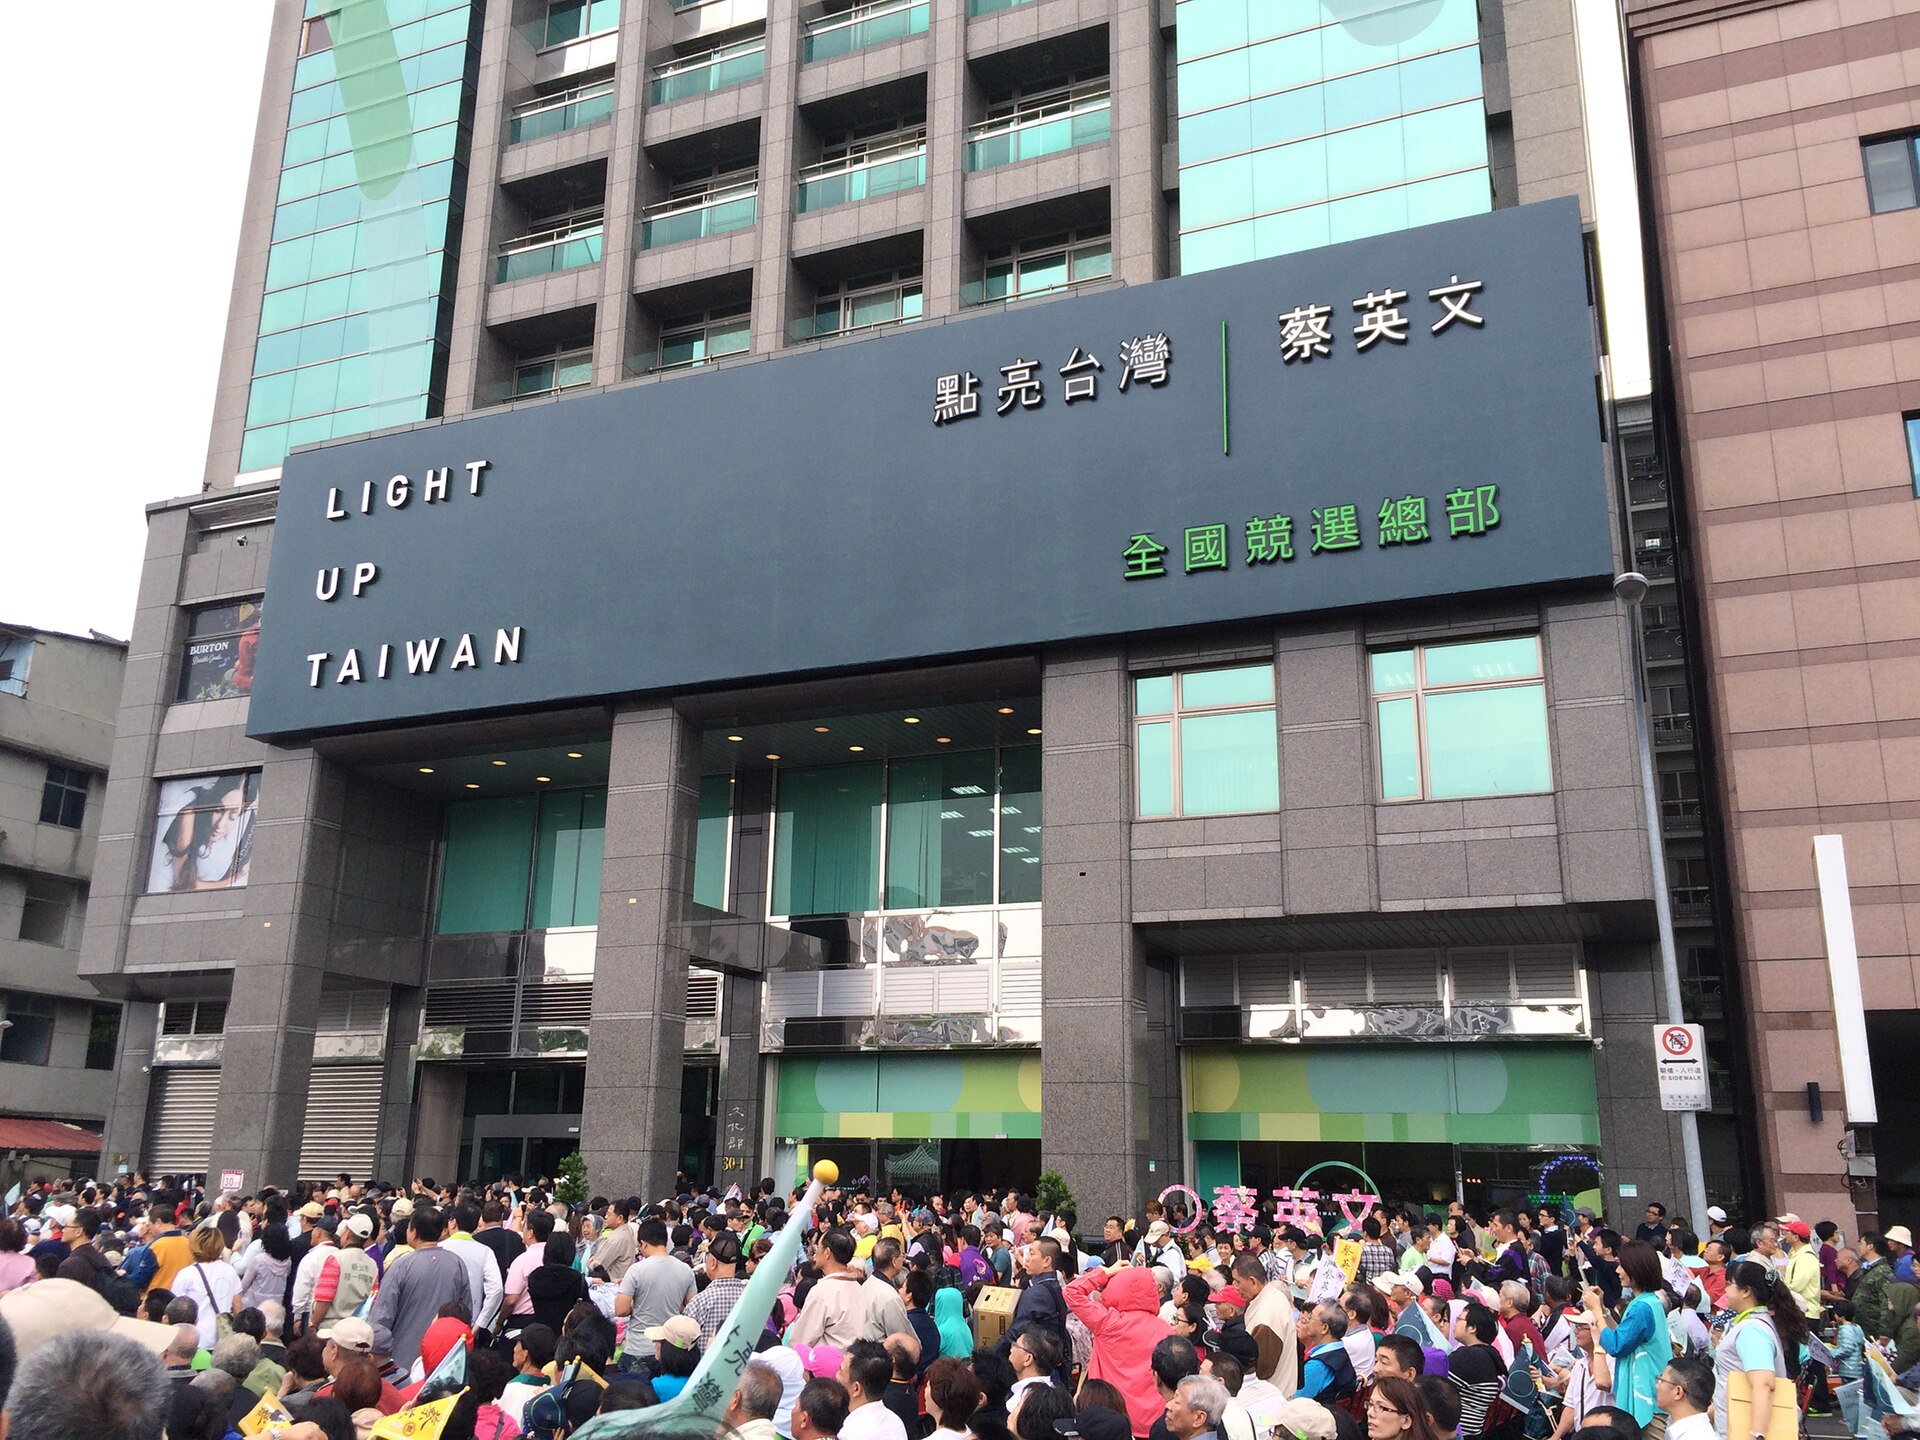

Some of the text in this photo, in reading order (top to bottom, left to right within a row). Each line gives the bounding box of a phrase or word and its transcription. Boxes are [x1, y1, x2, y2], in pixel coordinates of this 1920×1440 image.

[1278, 274, 1484, 362] 蔡英文
[932, 331, 1171, 425] 點亮台灣
[326, 459, 488, 520] LIGHT
[1122, 484, 1500, 580] 全國競選總部
[316, 561, 376, 601] UP
[189, 641, 229, 655] BURTON
[307, 626, 521, 687] TAIWAN
[1212, 1185, 1380, 1235] 蔡英文
